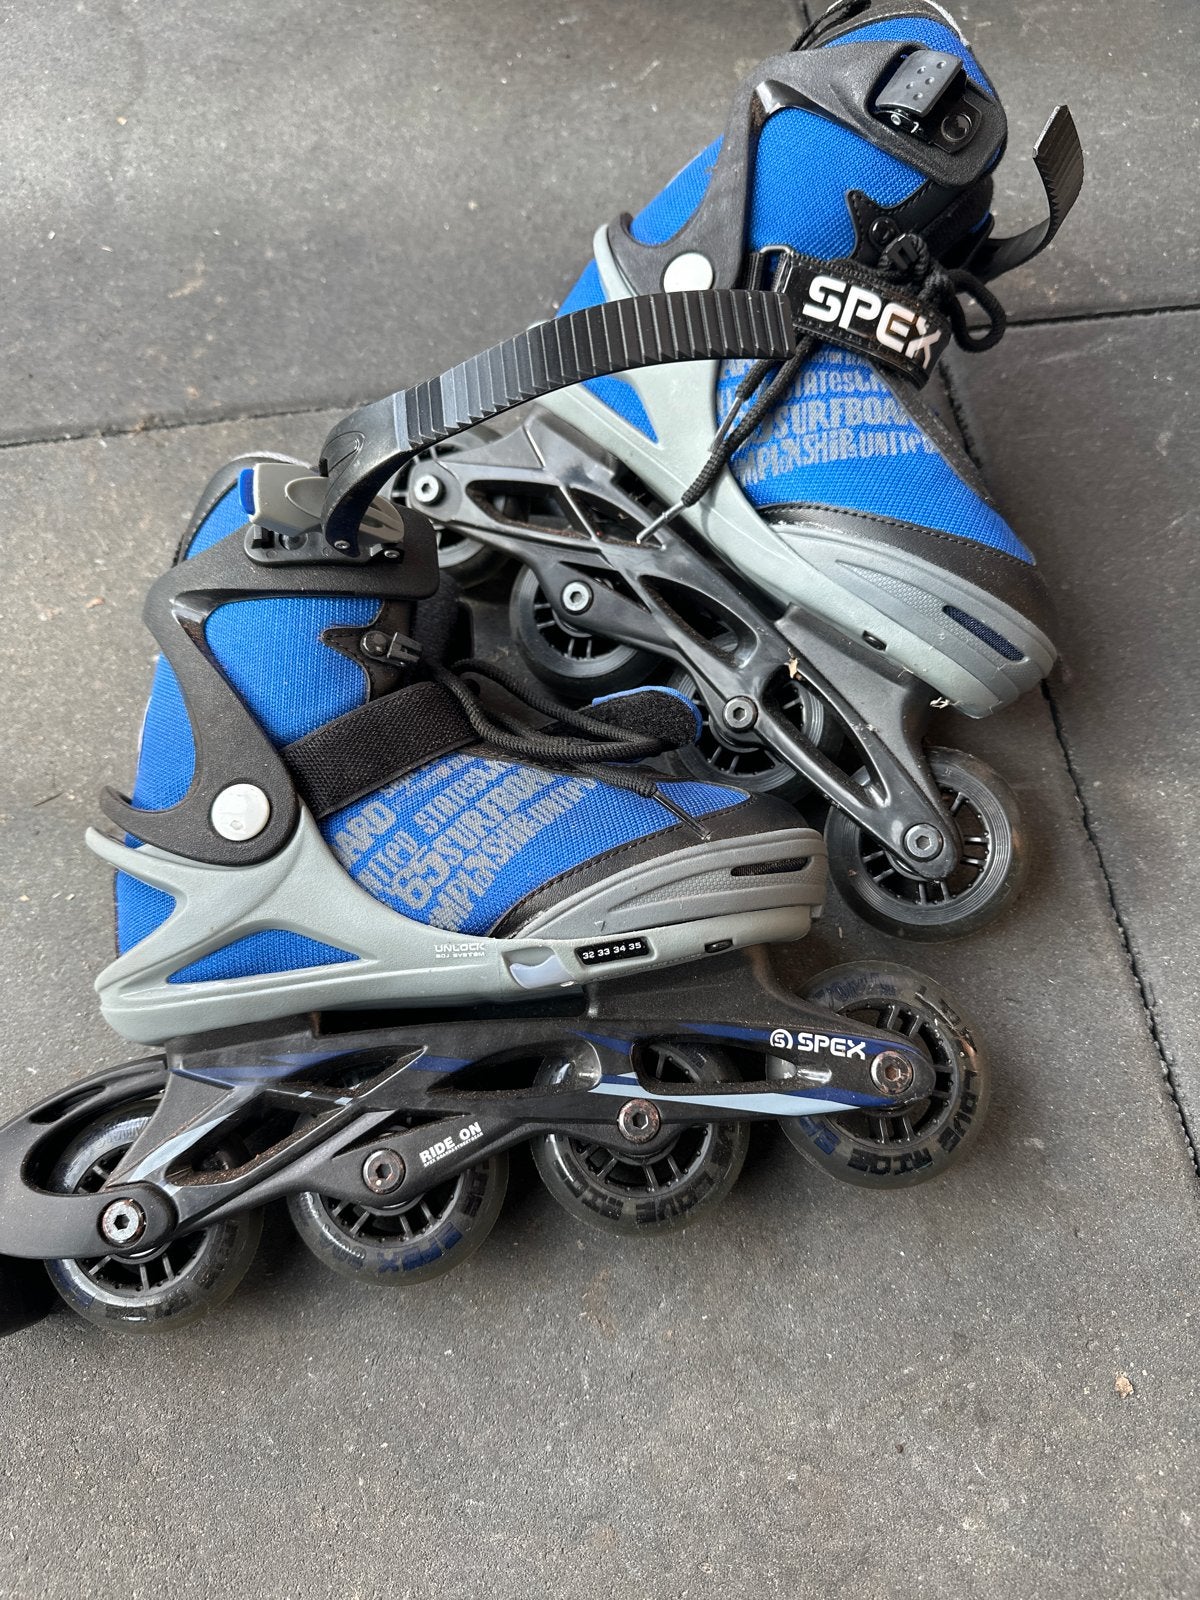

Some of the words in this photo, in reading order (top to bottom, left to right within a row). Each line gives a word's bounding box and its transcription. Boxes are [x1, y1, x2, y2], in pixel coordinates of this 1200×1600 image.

[802, 275, 942, 371] SPEX
[434, 943, 485, 953] UNLOCK
[582, 951, 595, 960] 32
[597, 948, 610, 957] 33
[613, 945, 626, 954] 34
[628, 941, 642, 950] 35
[797, 1032, 866, 1060] SPEX
[419, 1136, 456, 1164] RIDE
[459, 1121, 482, 1141] ON
